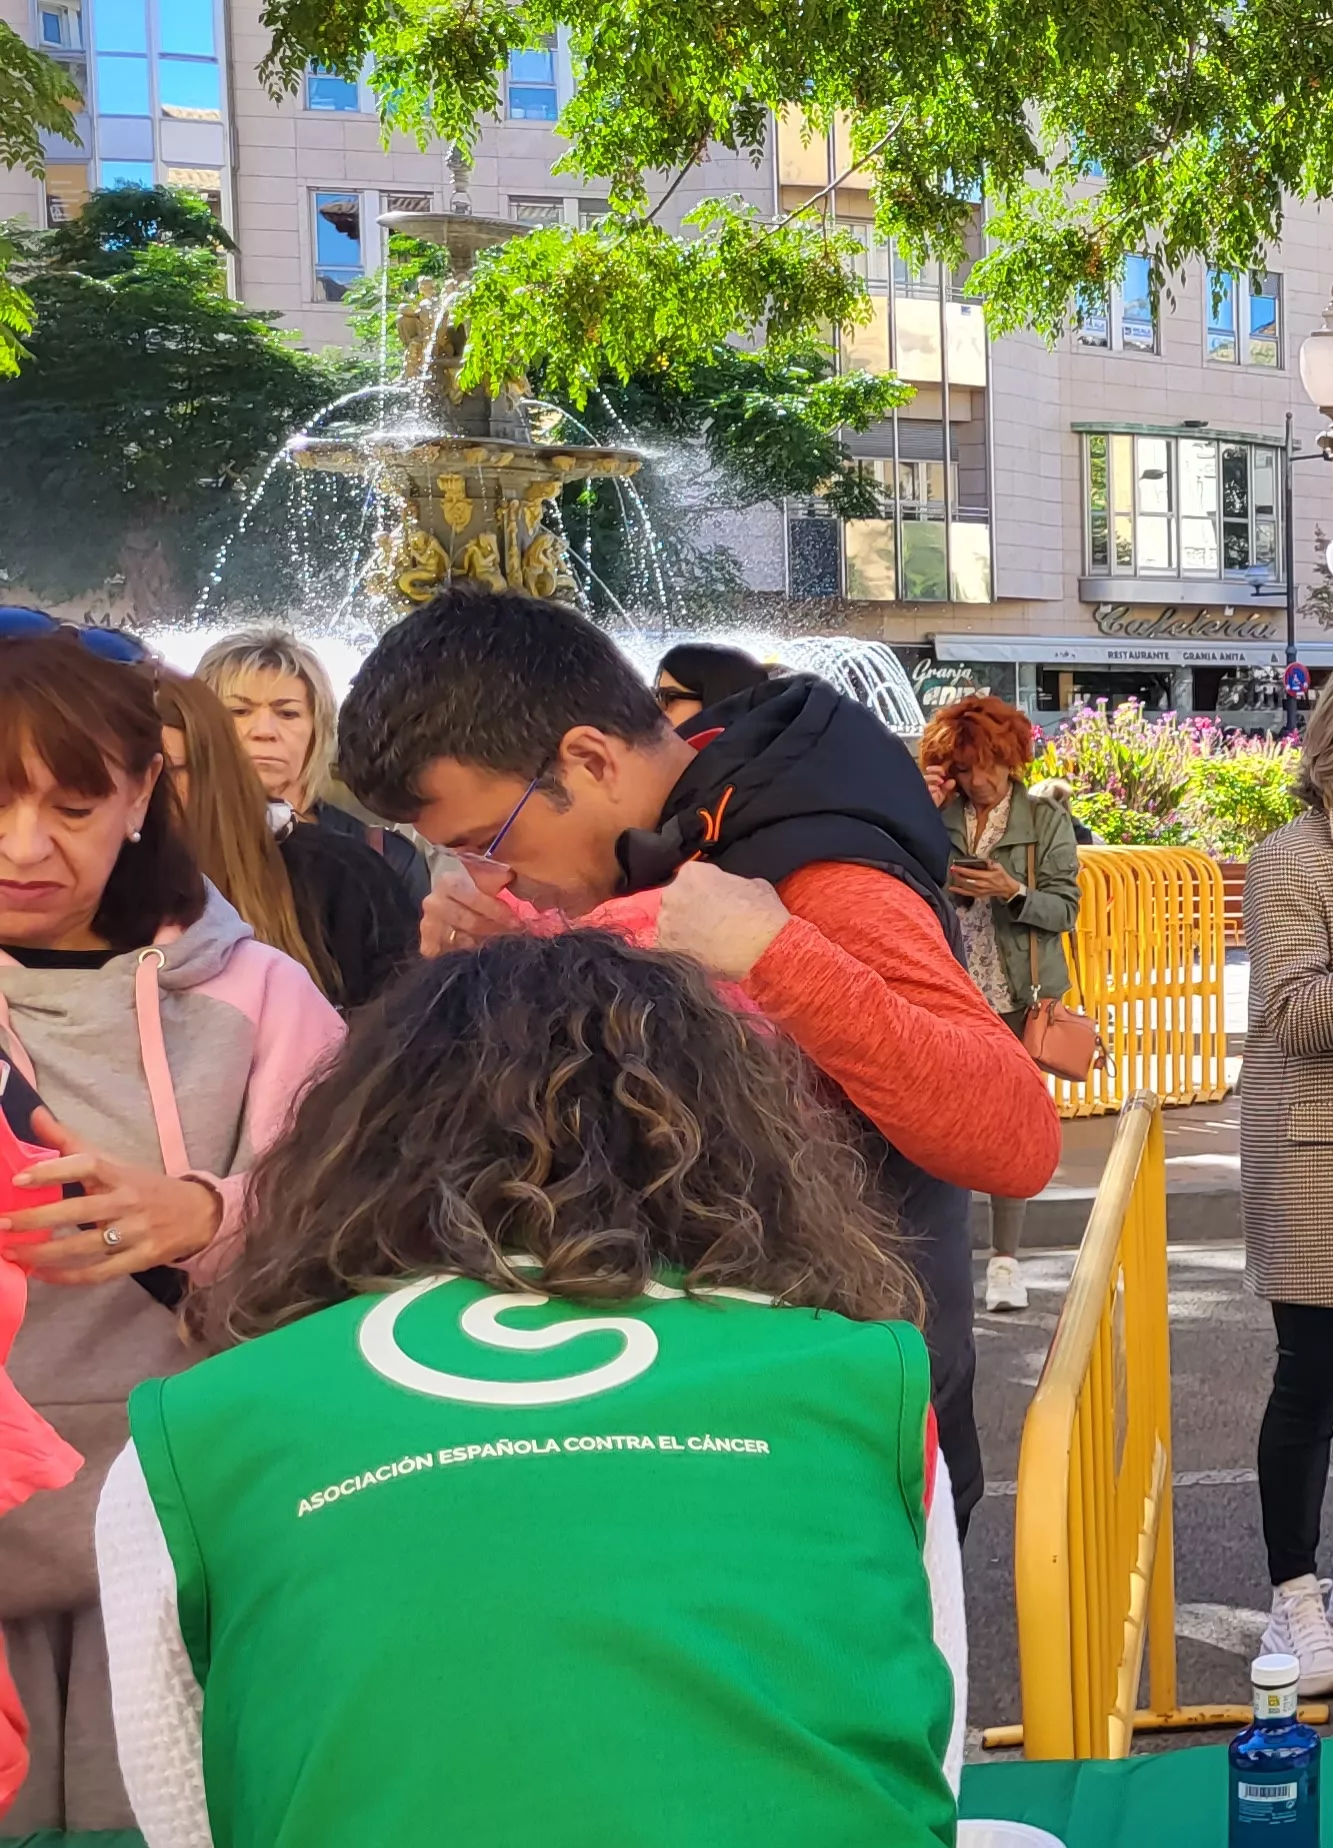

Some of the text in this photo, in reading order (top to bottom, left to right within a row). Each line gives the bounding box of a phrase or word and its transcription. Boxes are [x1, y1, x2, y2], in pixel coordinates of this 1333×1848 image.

[1107, 650, 1246, 662] RESTAURANTE GRANJA ANITA
[912, 658, 973, 694] Granja
[297, 1433, 771, 1518] ASOCIACIÓN ESPAÑOLA CONTRA EL CÁNCER
